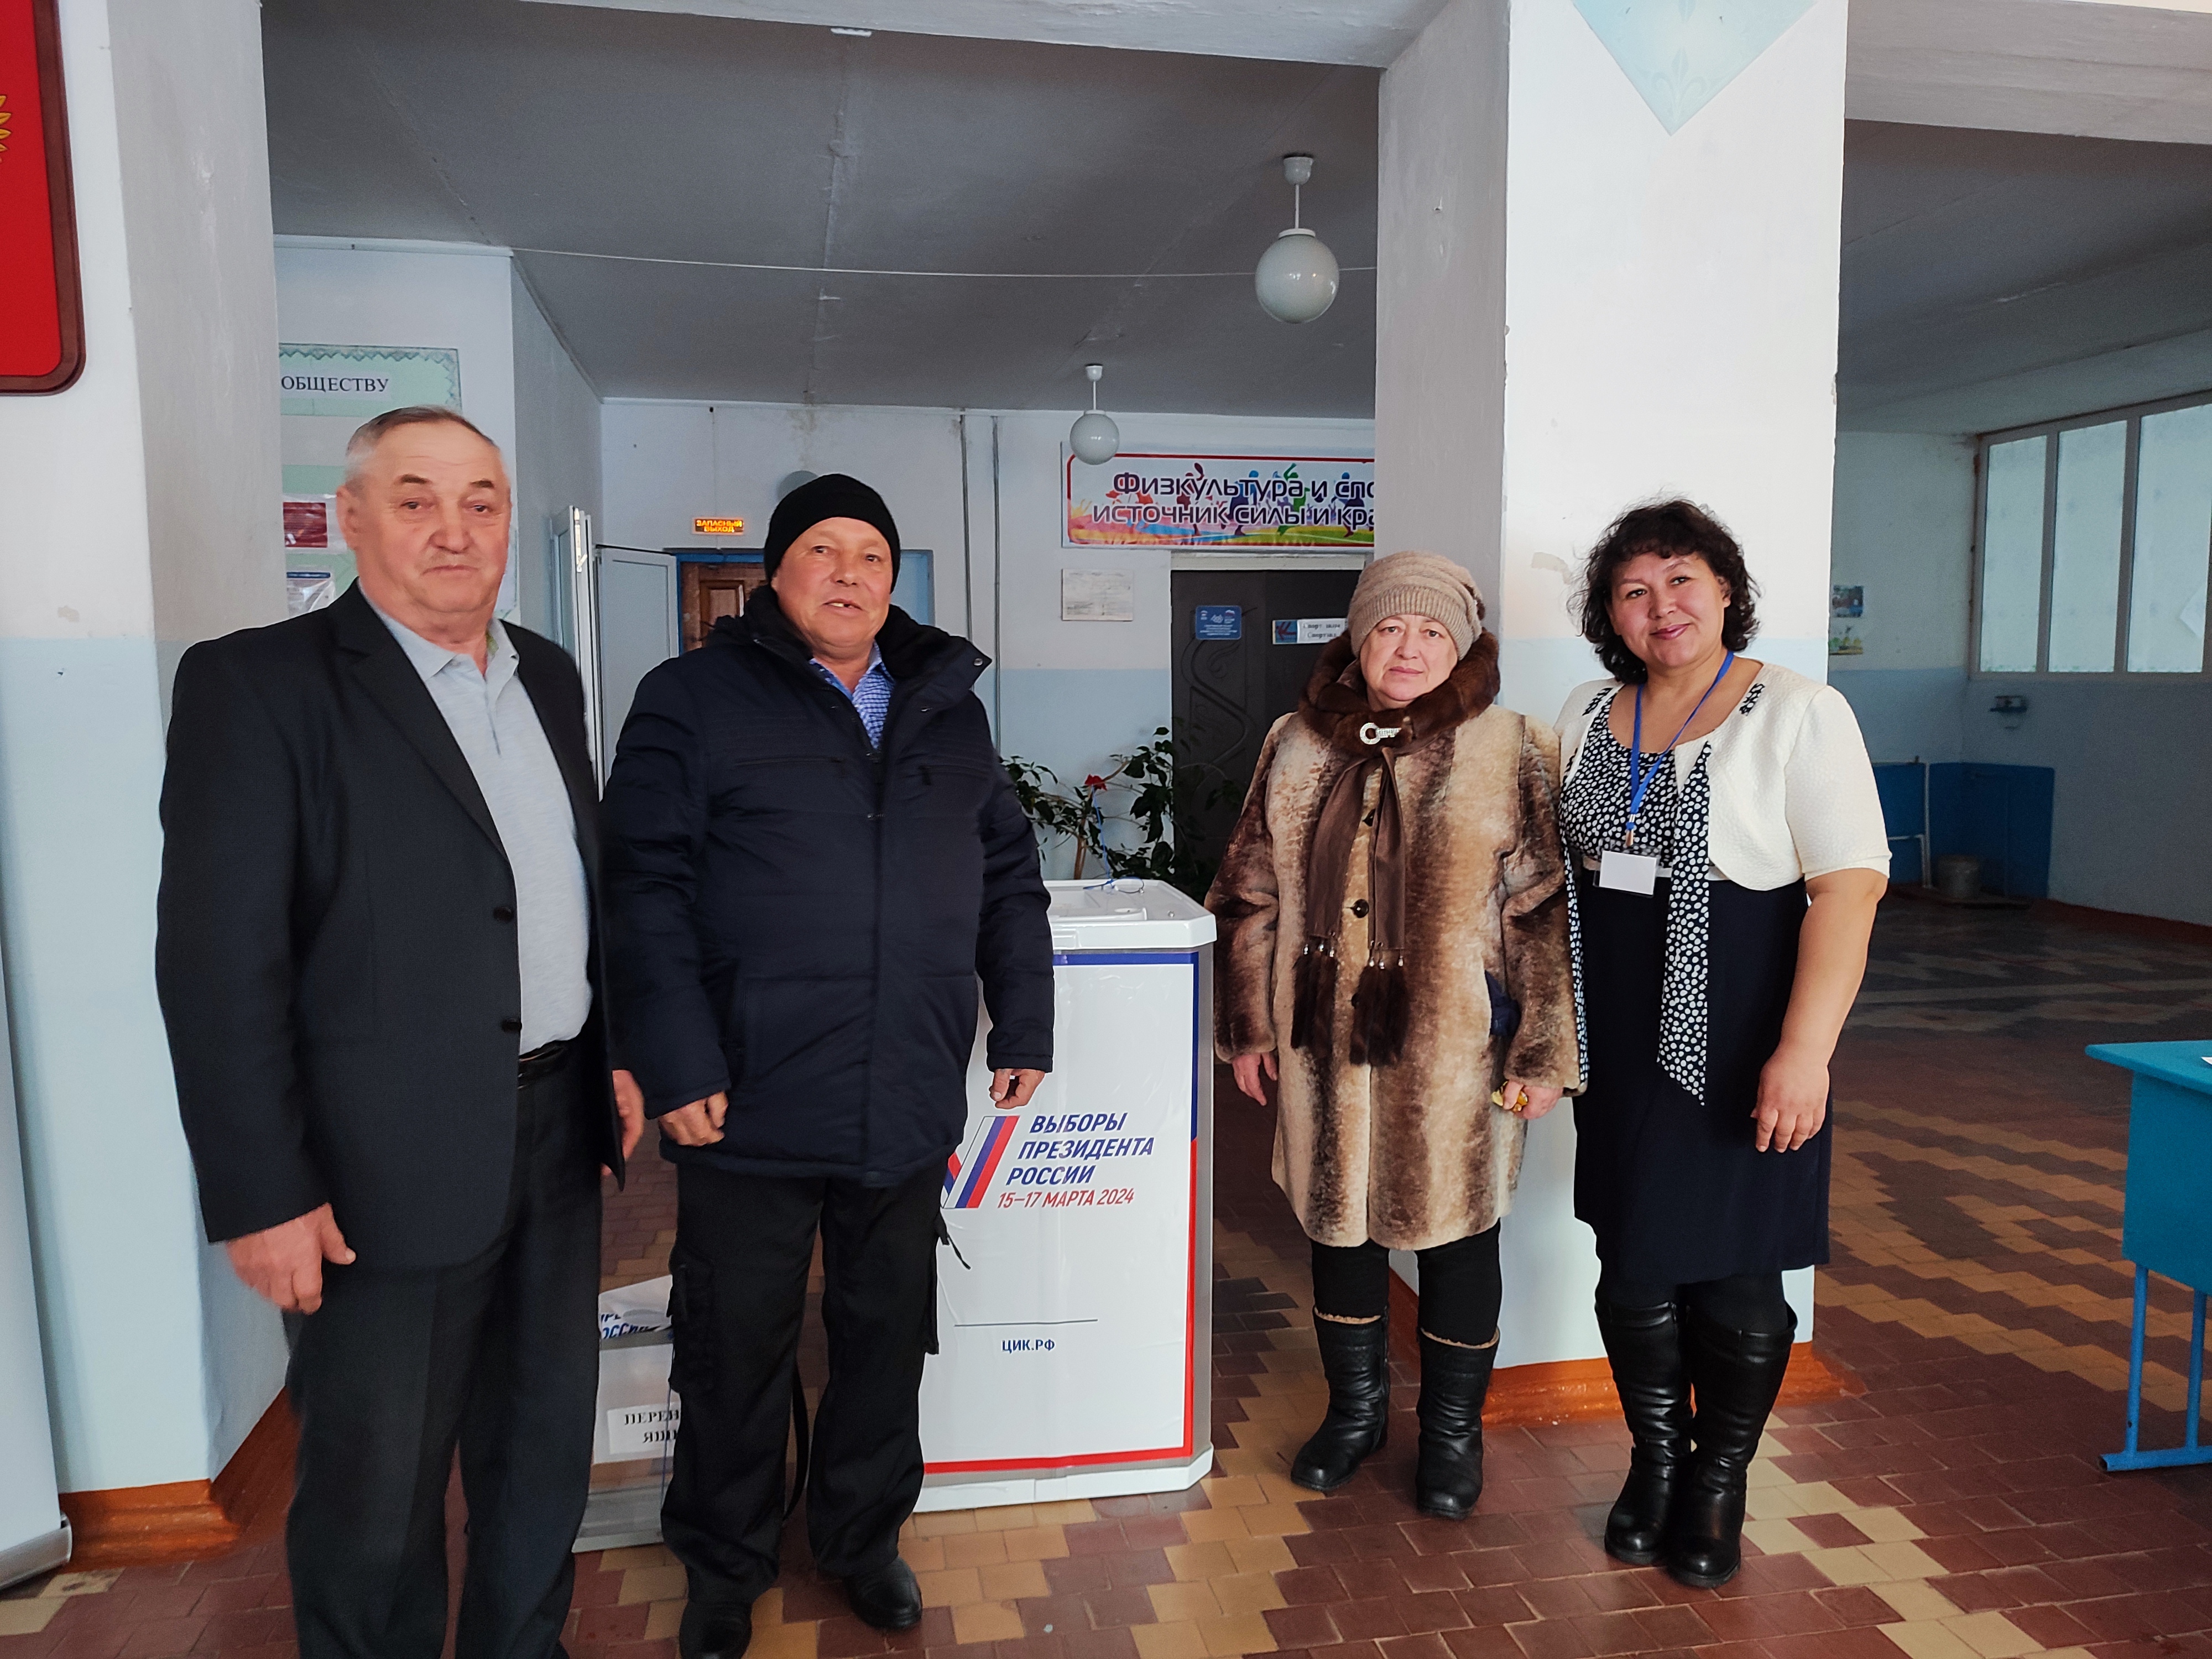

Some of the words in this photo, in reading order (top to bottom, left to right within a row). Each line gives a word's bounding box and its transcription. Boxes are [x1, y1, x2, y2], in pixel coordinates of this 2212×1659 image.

[281, 375, 389, 393] ОБЩЕСТВУ
[1113, 472, 1303, 502] Физкультура
[1311, 480, 1327, 498] и
[1093, 505, 1229, 524] источник
[1235, 507, 1305, 525] силы
[1313, 508, 1329, 525] и
[1029, 1112, 1128, 1134] ВЫБОРЫ
[1017, 1137, 1155, 1161] ПРЕЗИДЕНТА
[1005, 1165, 1096, 1186] РОССИИ
[1041, 1189, 1095, 1208] МАРТА
[1096, 1187, 1135, 1206] 2024
[1001, 1339, 1055, 1354] ЦИК.РФ
